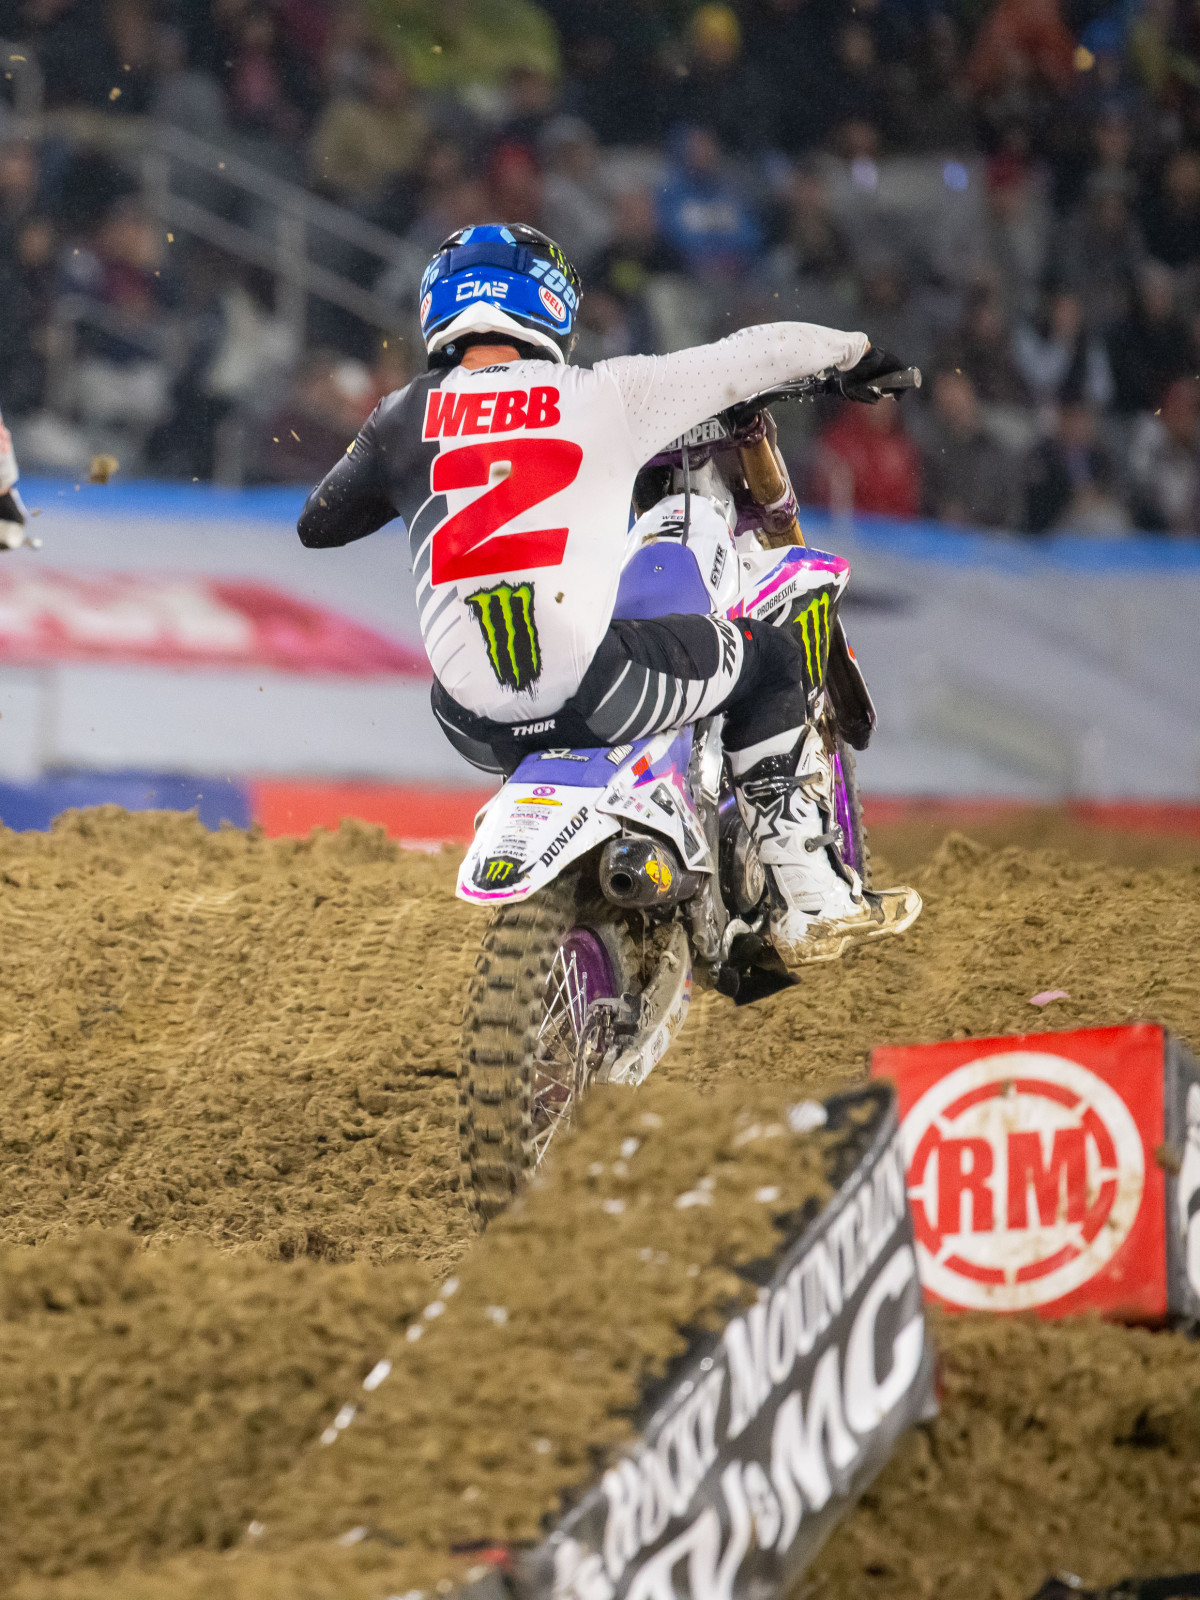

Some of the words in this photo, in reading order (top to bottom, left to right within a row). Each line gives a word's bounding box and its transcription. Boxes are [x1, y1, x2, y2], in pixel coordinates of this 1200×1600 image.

[529, 258, 579, 311] 100
[543, 289, 563, 317] BELL
[422, 385, 562, 440] WEBB
[430, 437, 583, 586] 2
[710, 542, 726, 588] GYTR
[756, 579, 798, 620] PROGRESSIVE
[511, 719, 556, 737] THOR
[538, 805, 589, 868] DUNLOP
[936, 1127, 1089, 1235] RM
